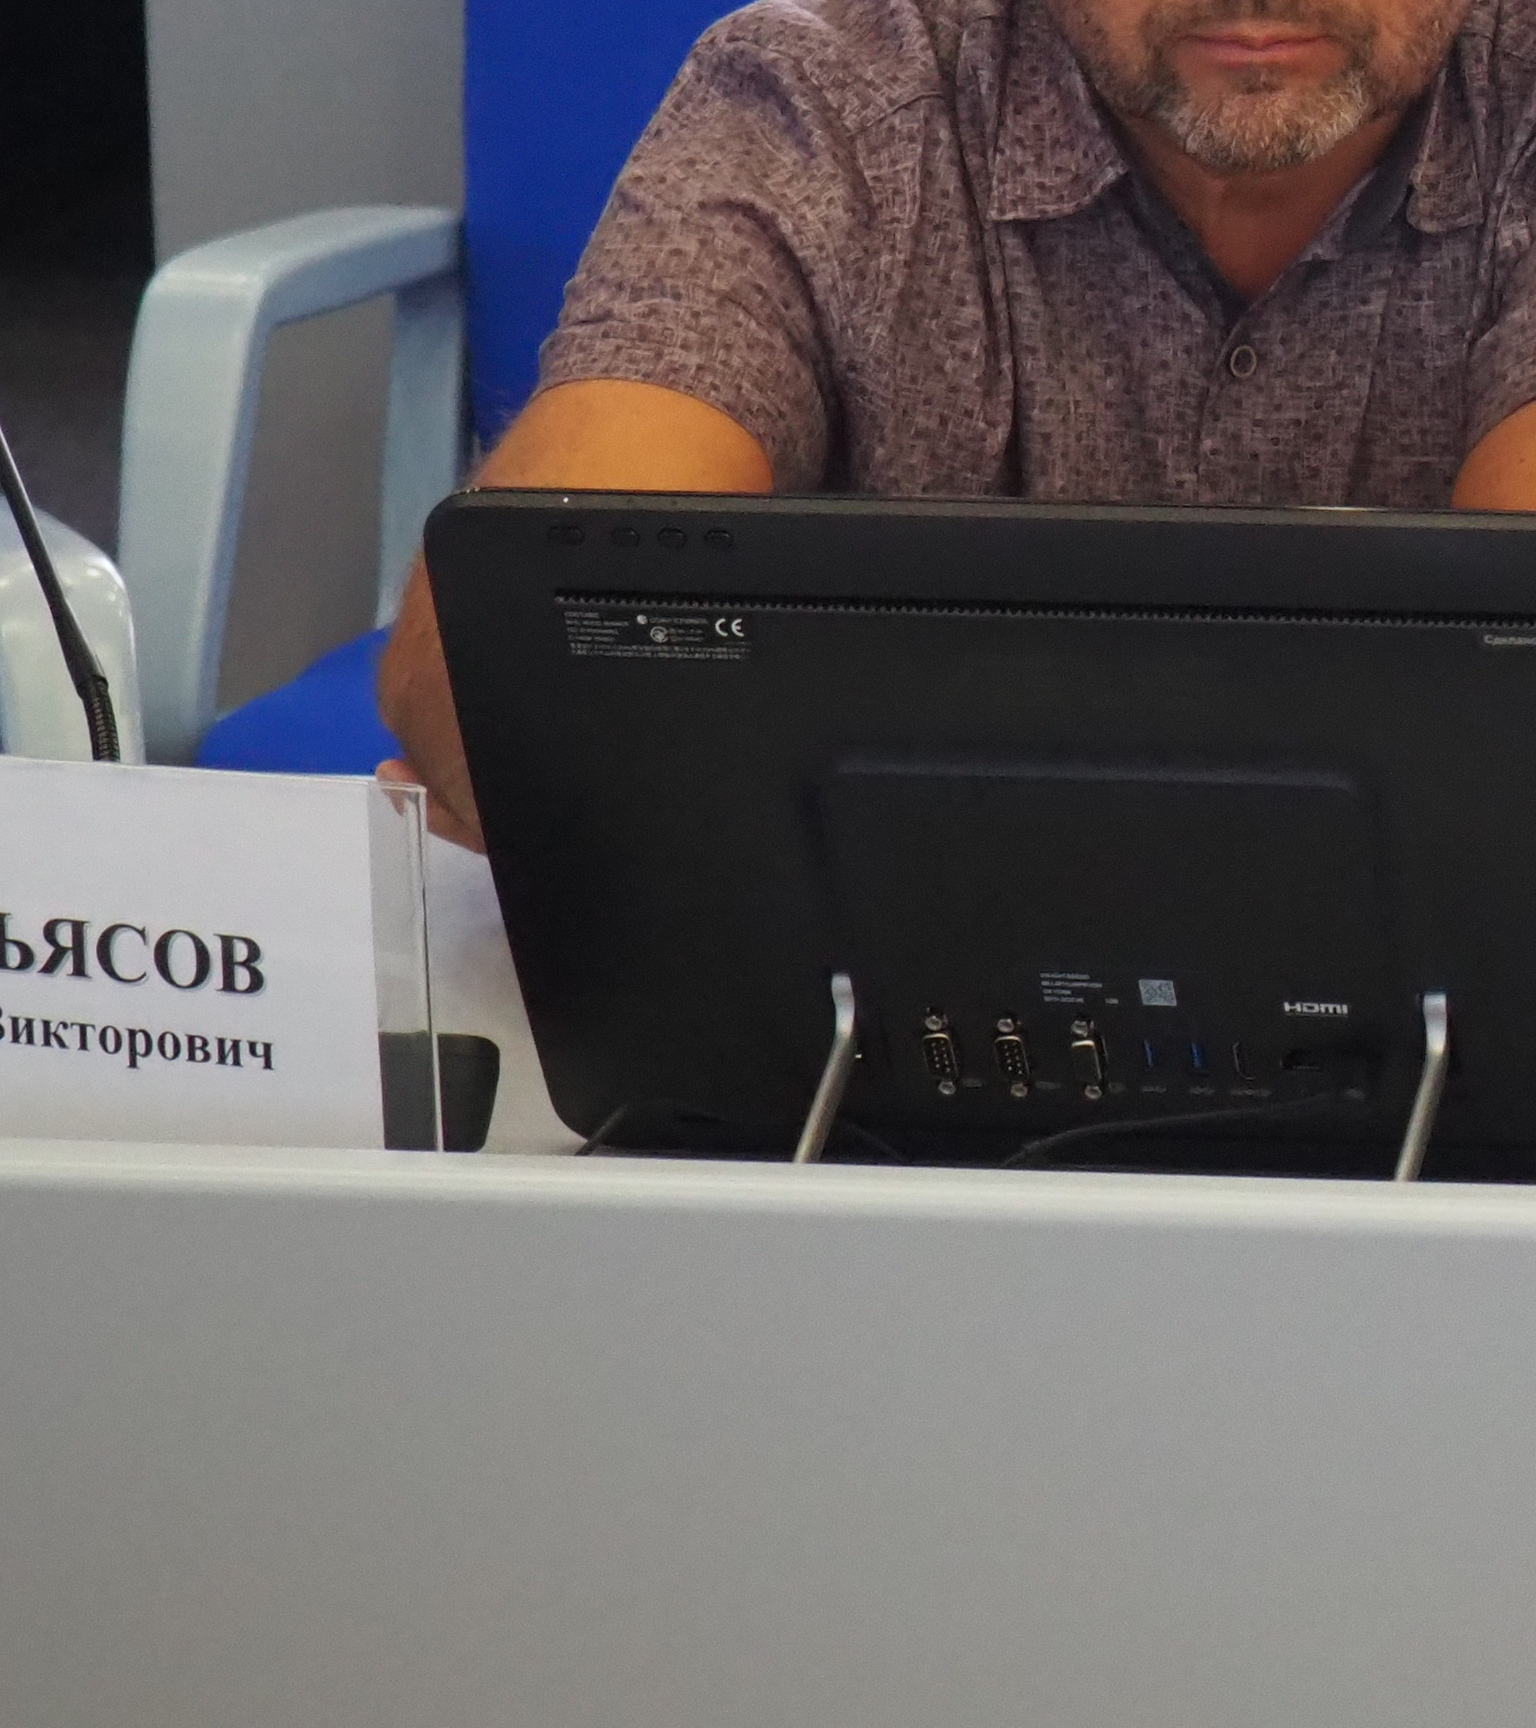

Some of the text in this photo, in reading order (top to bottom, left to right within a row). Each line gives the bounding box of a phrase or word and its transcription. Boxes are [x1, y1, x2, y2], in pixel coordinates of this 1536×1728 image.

[714, 617, 746, 638] CE
[0, 912, 266, 995] ЬЯСОВ
[1283, 1000, 1350, 1016] HDMI
[0, 1007, 274, 1071] икторович
